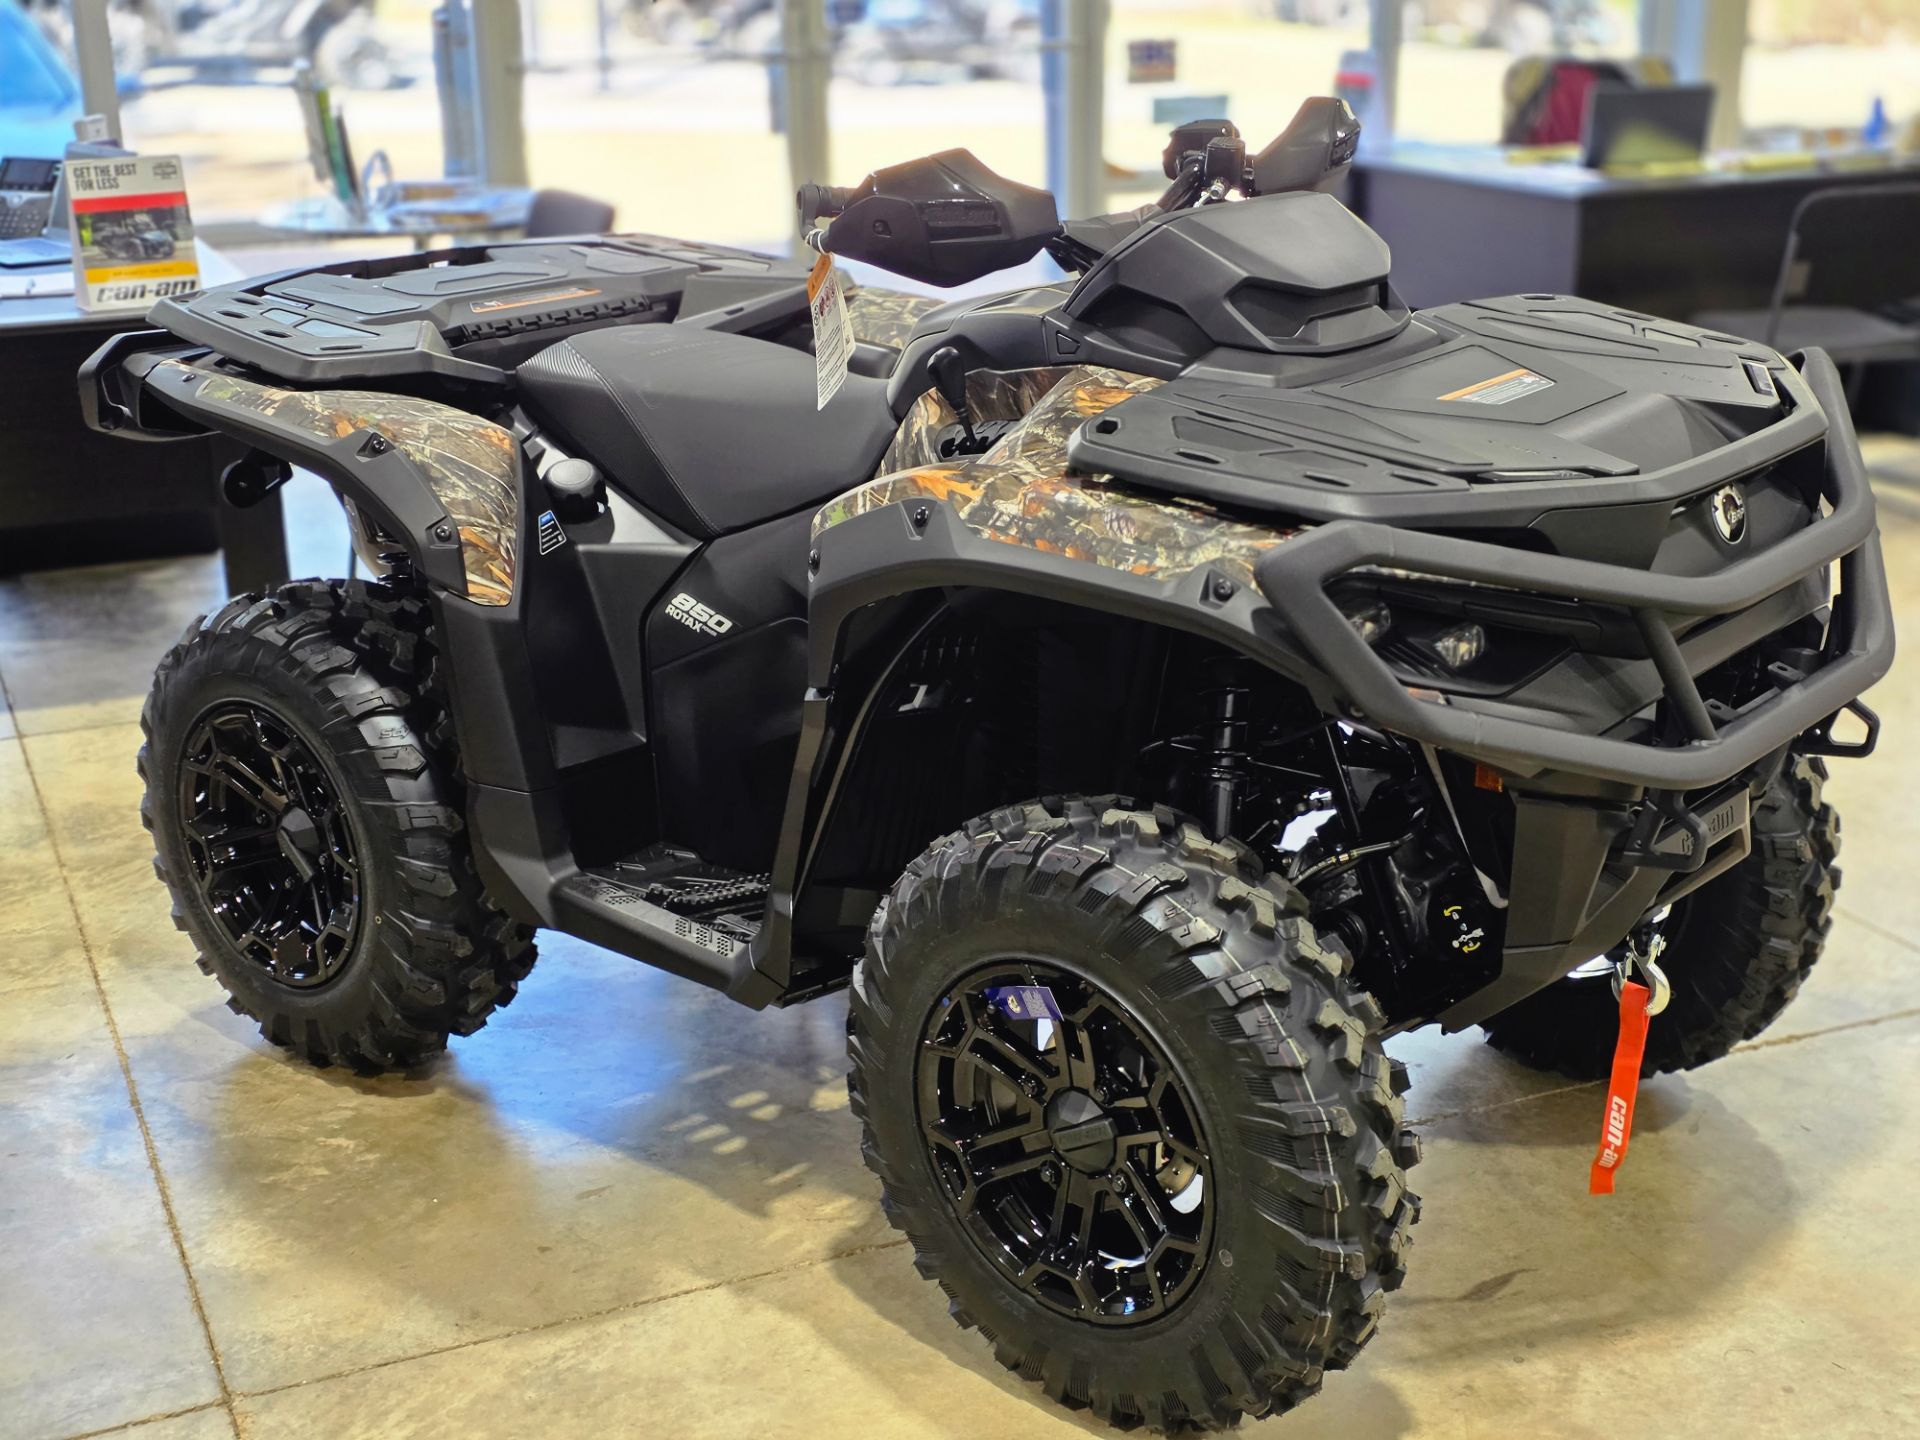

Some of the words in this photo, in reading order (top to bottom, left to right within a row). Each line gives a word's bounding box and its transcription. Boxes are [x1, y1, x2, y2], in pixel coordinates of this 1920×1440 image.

[73, 166, 91, 179] GET
[93, 164, 112, 177] THE
[114, 163, 137, 176] BEST
[75, 179, 95, 191] FOR
[97, 177, 119, 190] LESS
[97, 280, 196, 302] can-am
[664, 604, 703, 633] ROTAX
[671, 592, 733, 634] 850
